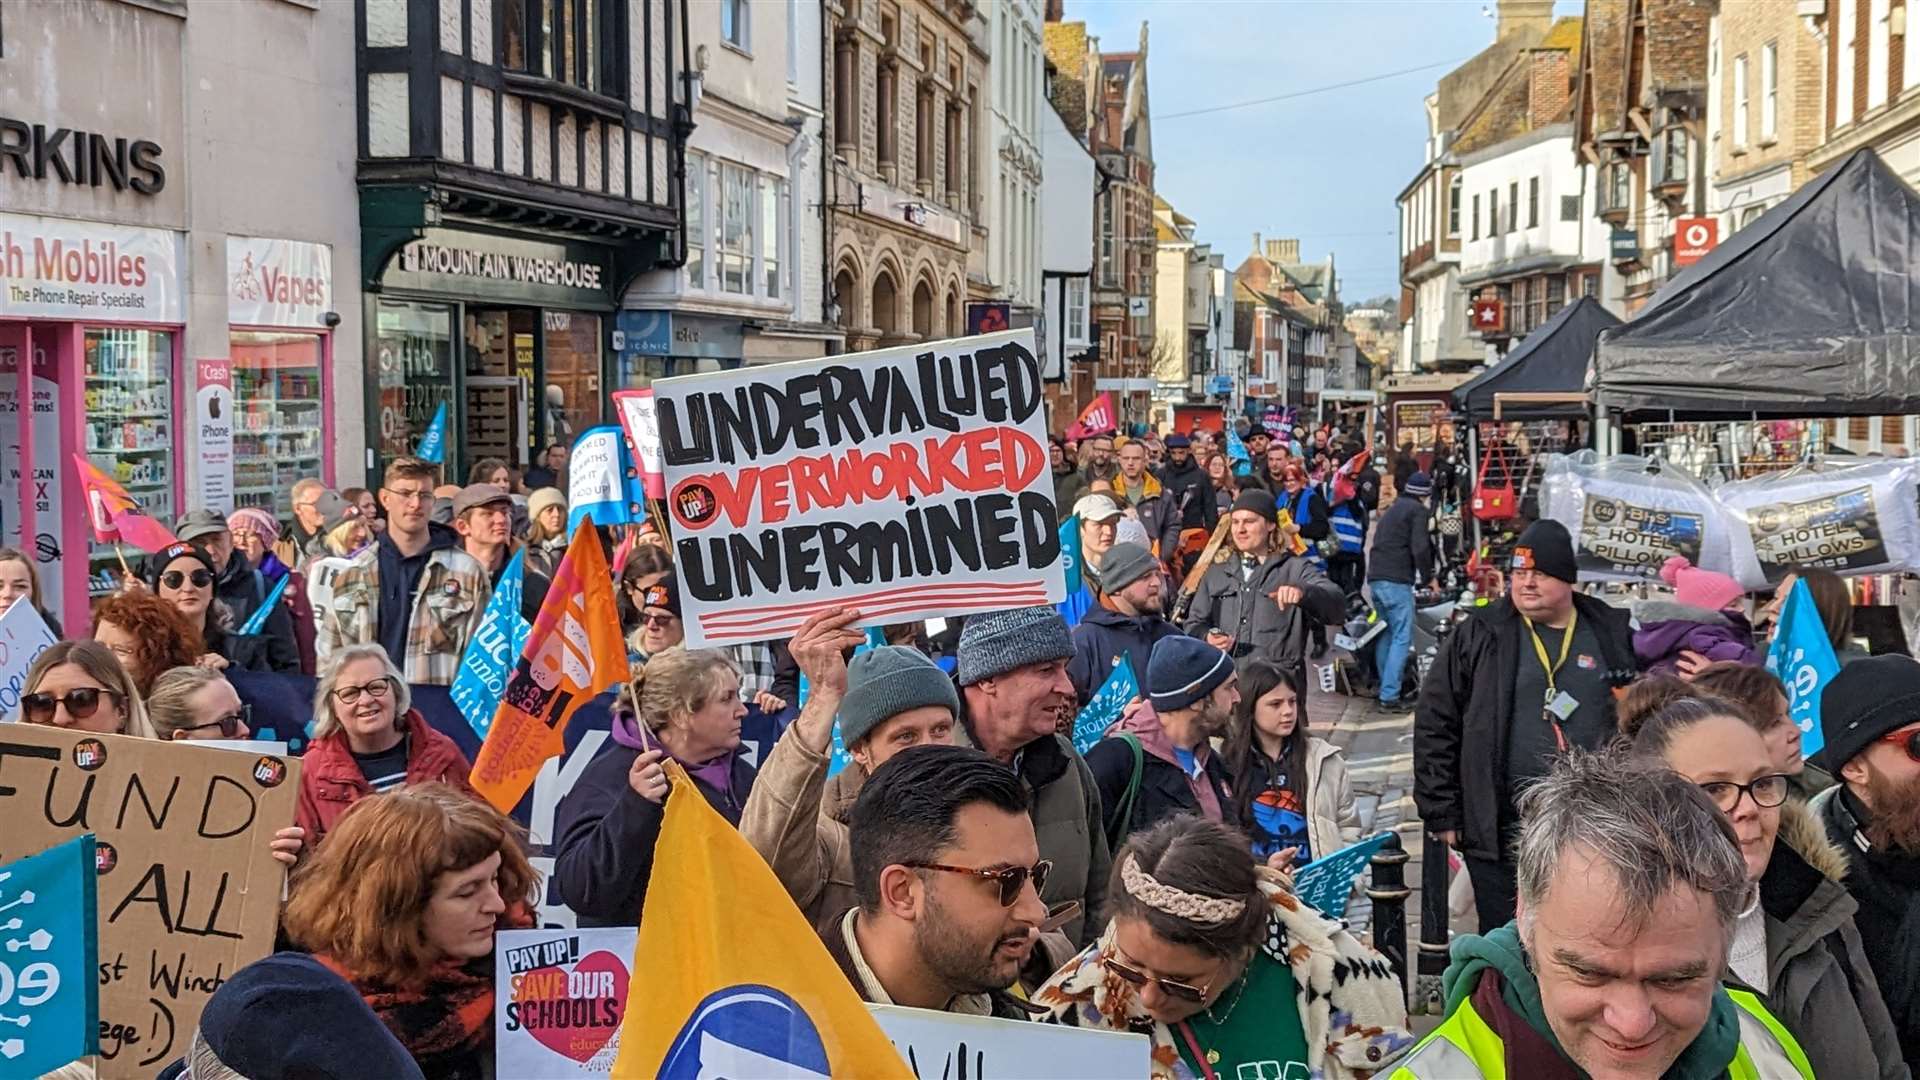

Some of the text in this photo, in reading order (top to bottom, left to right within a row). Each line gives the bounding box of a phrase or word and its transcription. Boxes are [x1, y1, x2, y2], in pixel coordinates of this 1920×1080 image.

[0, 117, 166, 196] RKINS
[0, 231, 147, 287] h Mobiles
[424, 244, 601, 289] MOUNTAIN WAREHOUSE
[10, 286, 145, 309] The Phone Repair Specialist
[261, 265, 324, 314] Vapes
[656, 341, 1042, 465] UNDERVALUED
[670, 426, 1046, 530] OVERWORKED
[1608, 528, 1673, 550] HOTEL
[1775, 536, 1864, 565] PILLOWS
[1781, 522, 1848, 546] HOTEL
[1594, 545, 1668, 563] PILLOW
[76, 742, 99, 753] PAY
[260, 757, 282, 770] PAY
[0, 743, 256, 839] FUND
[108, 863, 244, 940] ALL
[98, 952, 128, 985] st
[507, 936, 579, 973] PAY UP!
[510, 971, 615, 1002] SAVE OUR
[505, 998, 619, 1032] SCHOOLS
